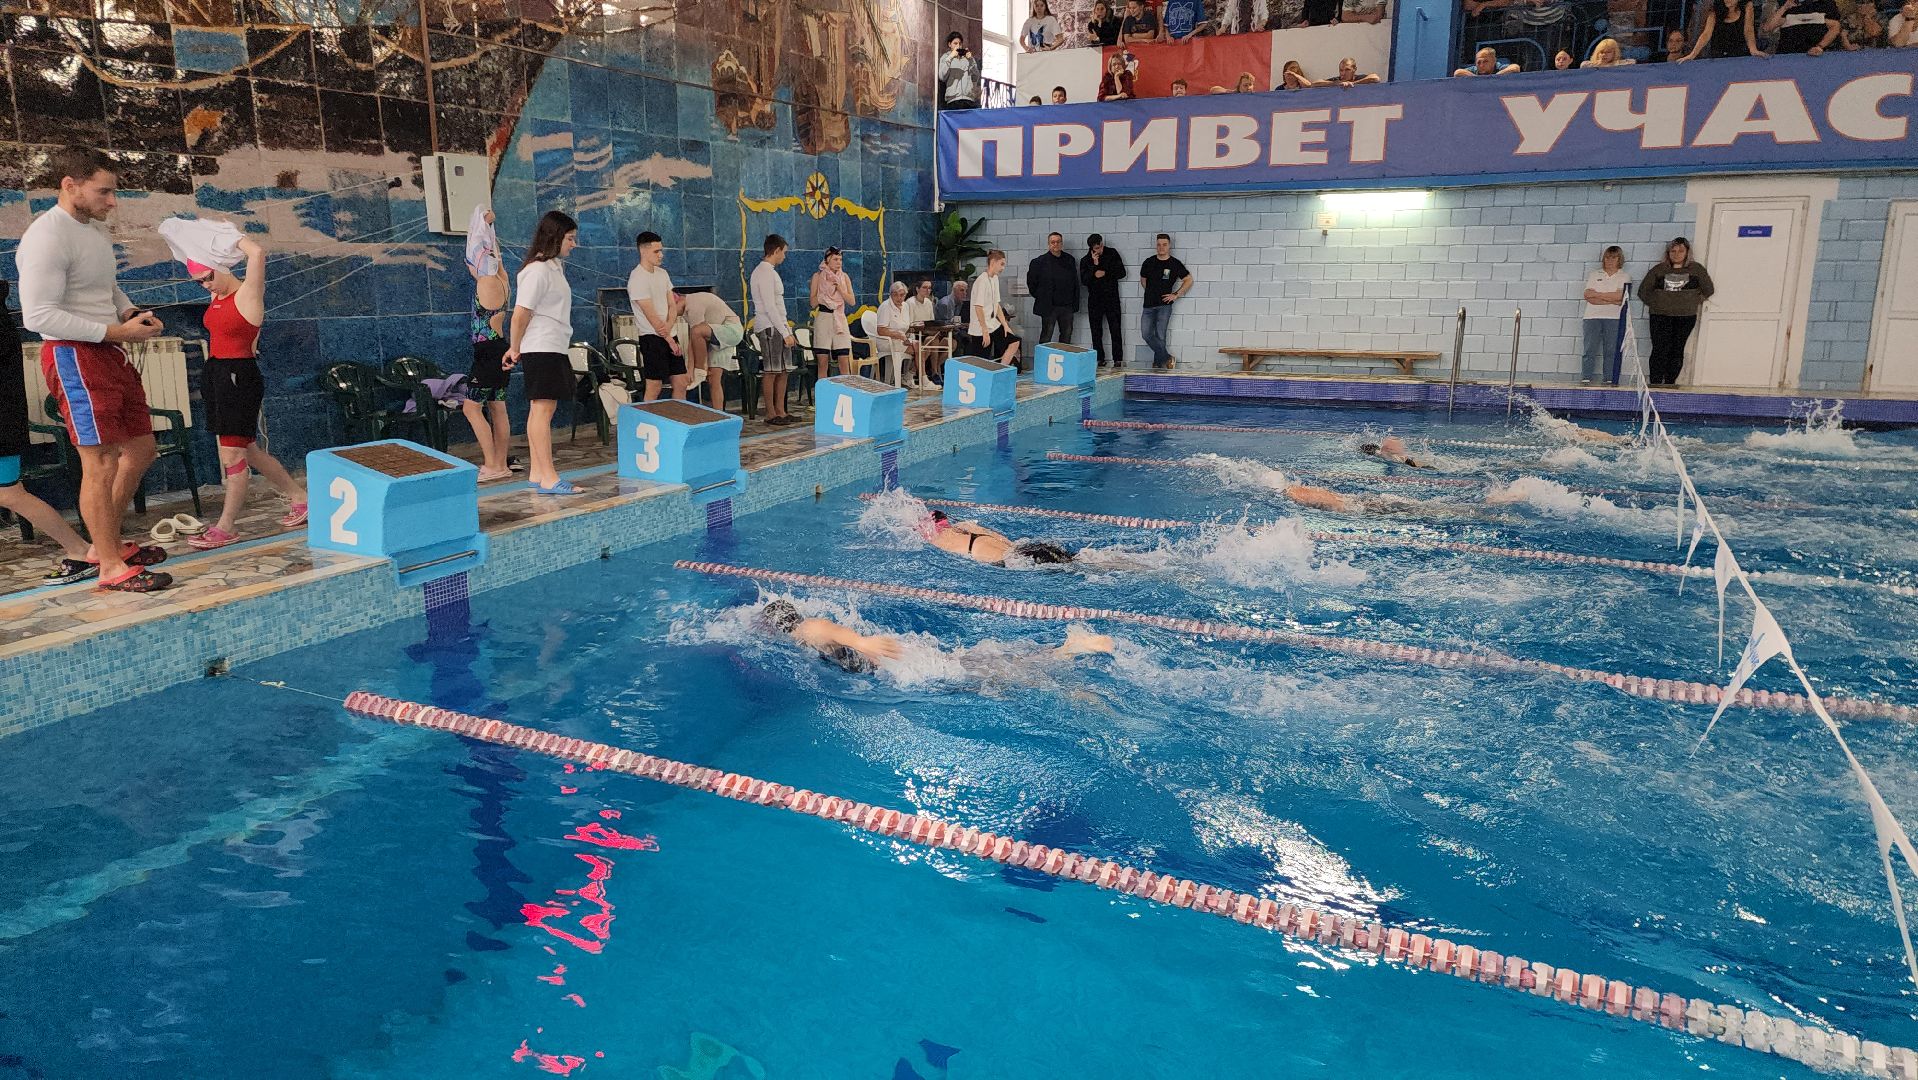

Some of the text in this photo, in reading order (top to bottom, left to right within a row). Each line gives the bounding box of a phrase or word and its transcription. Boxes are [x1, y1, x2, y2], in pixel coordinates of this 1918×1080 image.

[957, 72, 1914, 179] ПРИВЕТ УЧАС
[957, 368, 977, 406] 5
[1046, 352, 1065, 383] 6
[832, 393, 855, 434] 4
[635, 422, 661, 474] 3
[328, 475, 359, 547] 2
